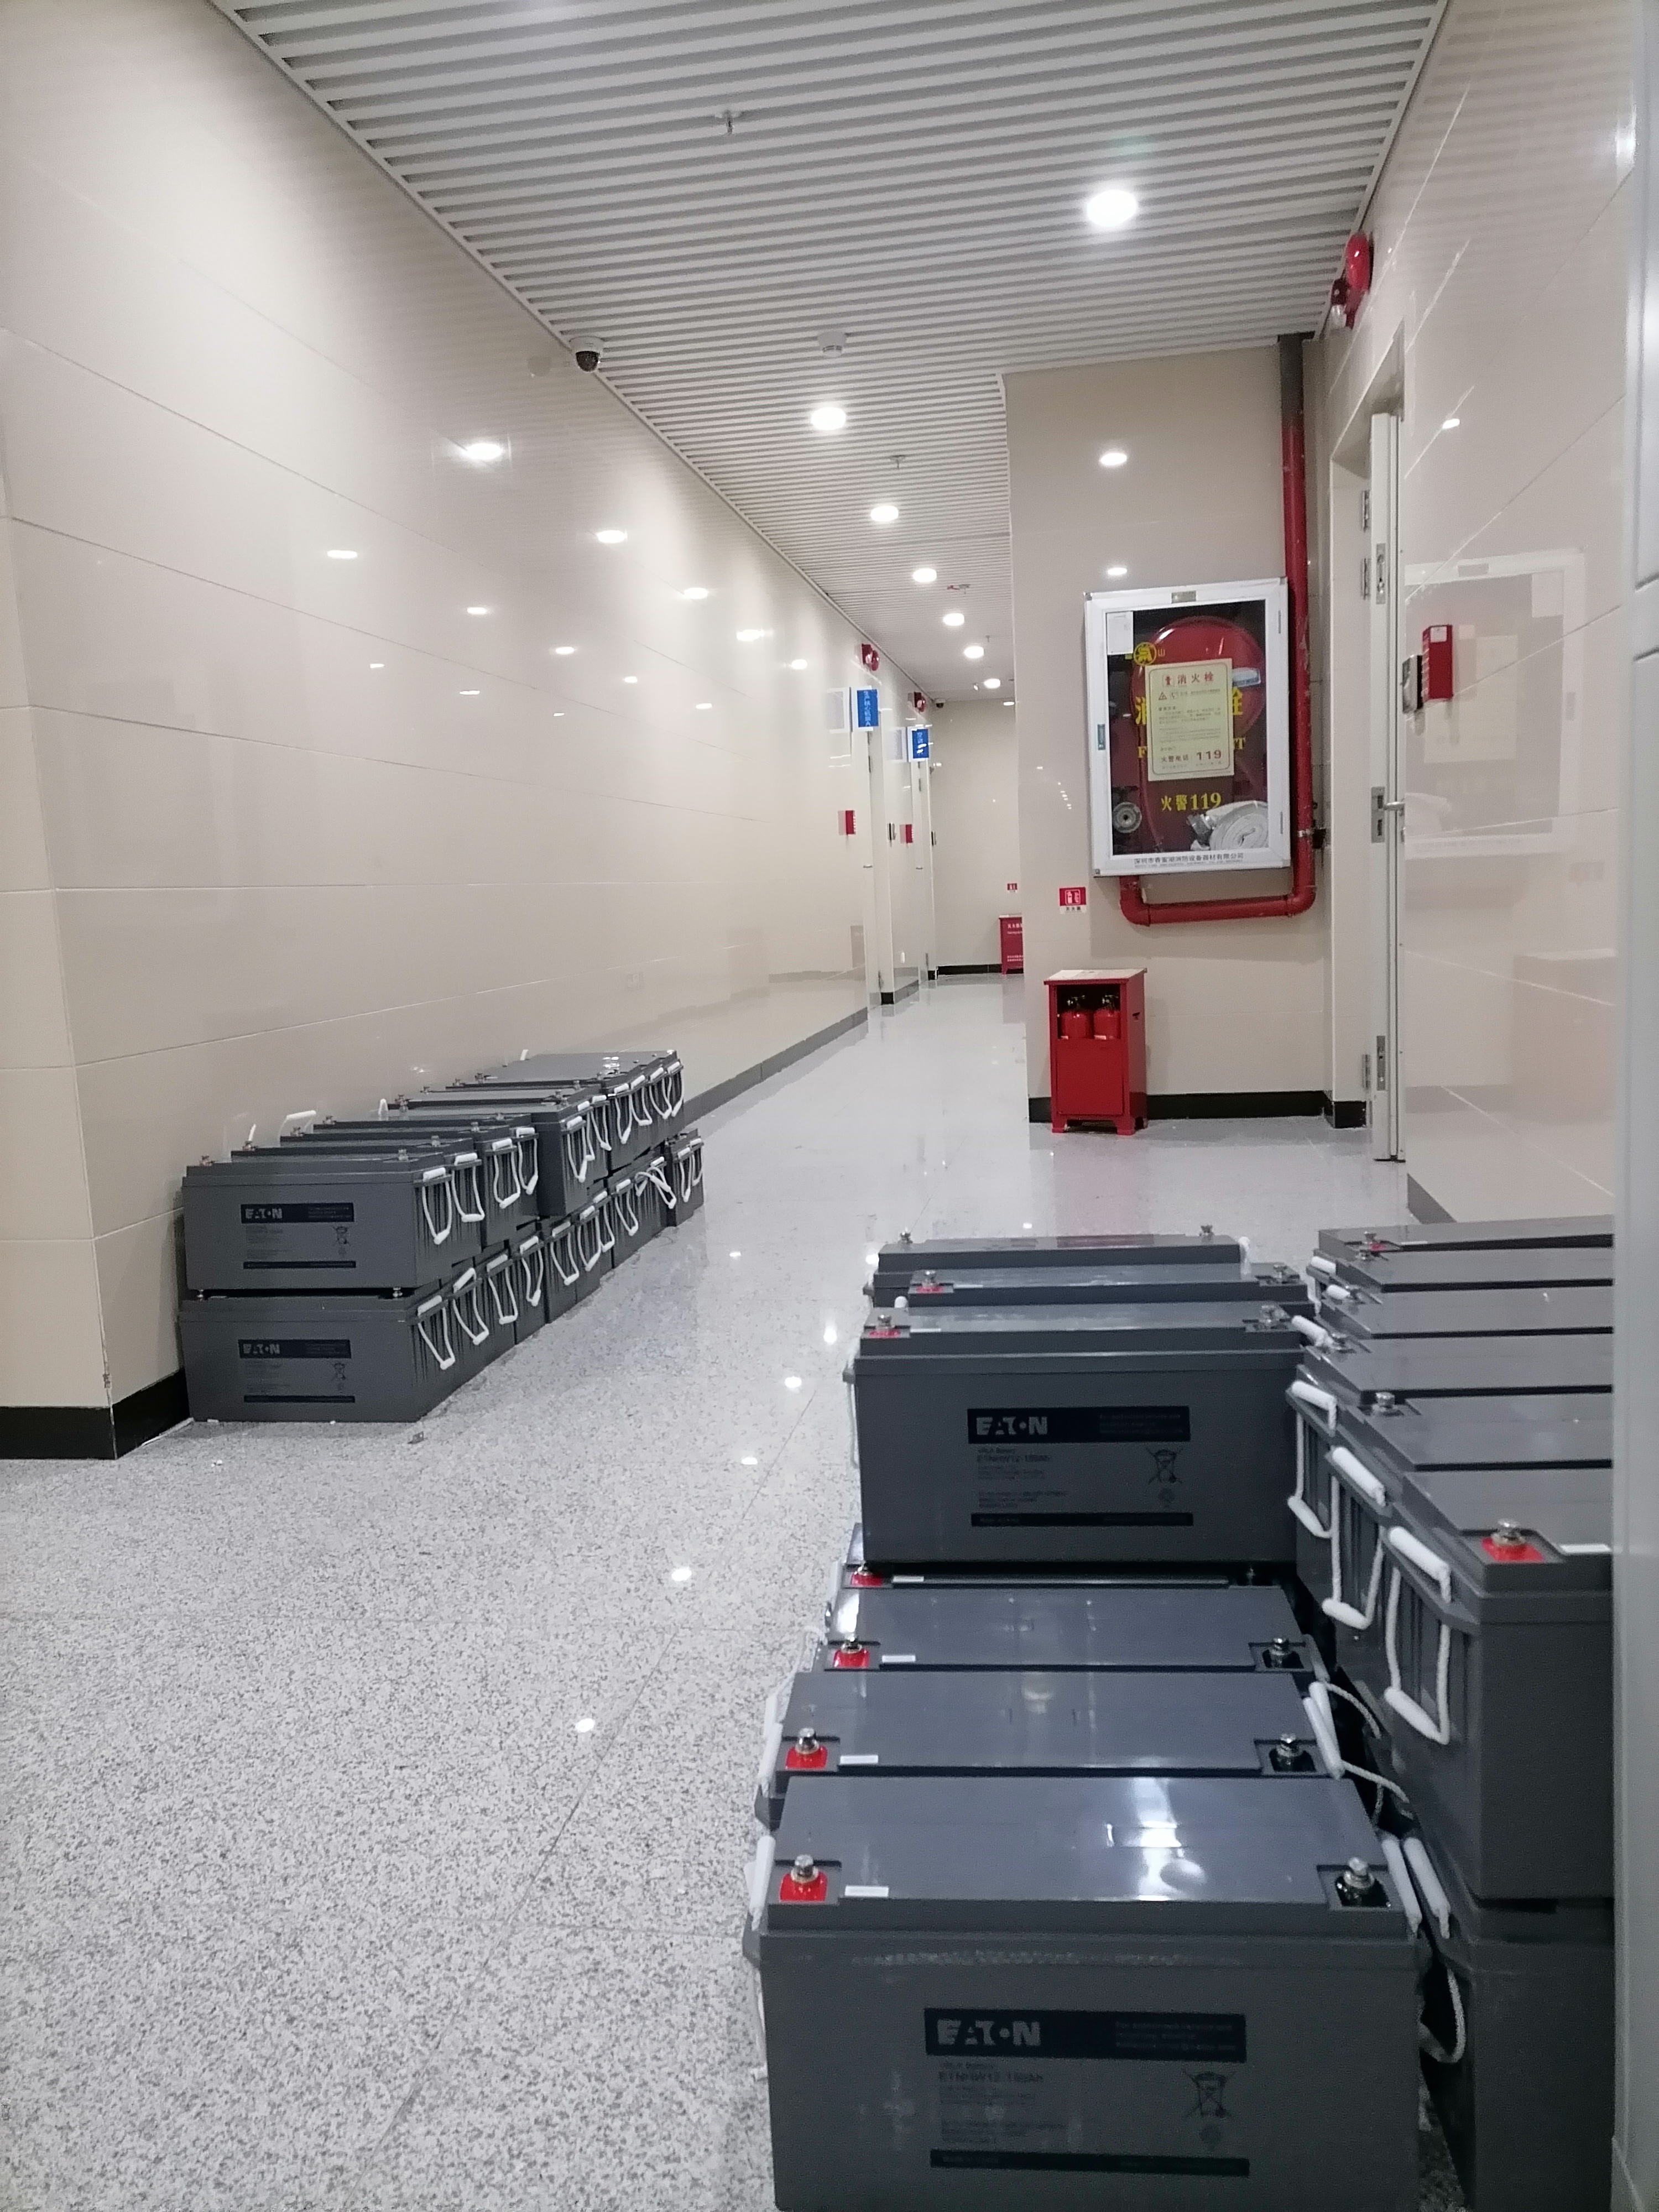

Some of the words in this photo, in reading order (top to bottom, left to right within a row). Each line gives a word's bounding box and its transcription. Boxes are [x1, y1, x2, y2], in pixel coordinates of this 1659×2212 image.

[1177, 671, 1213, 685] 消火栓
[1197, 749, 1222, 760] 119
[1161, 792, 1221, 811] 火警119
[246, 1208, 283, 1219] EATON
[976, 1416, 1047, 1435] EATON
[937, 2020, 1041, 2046] EATON
